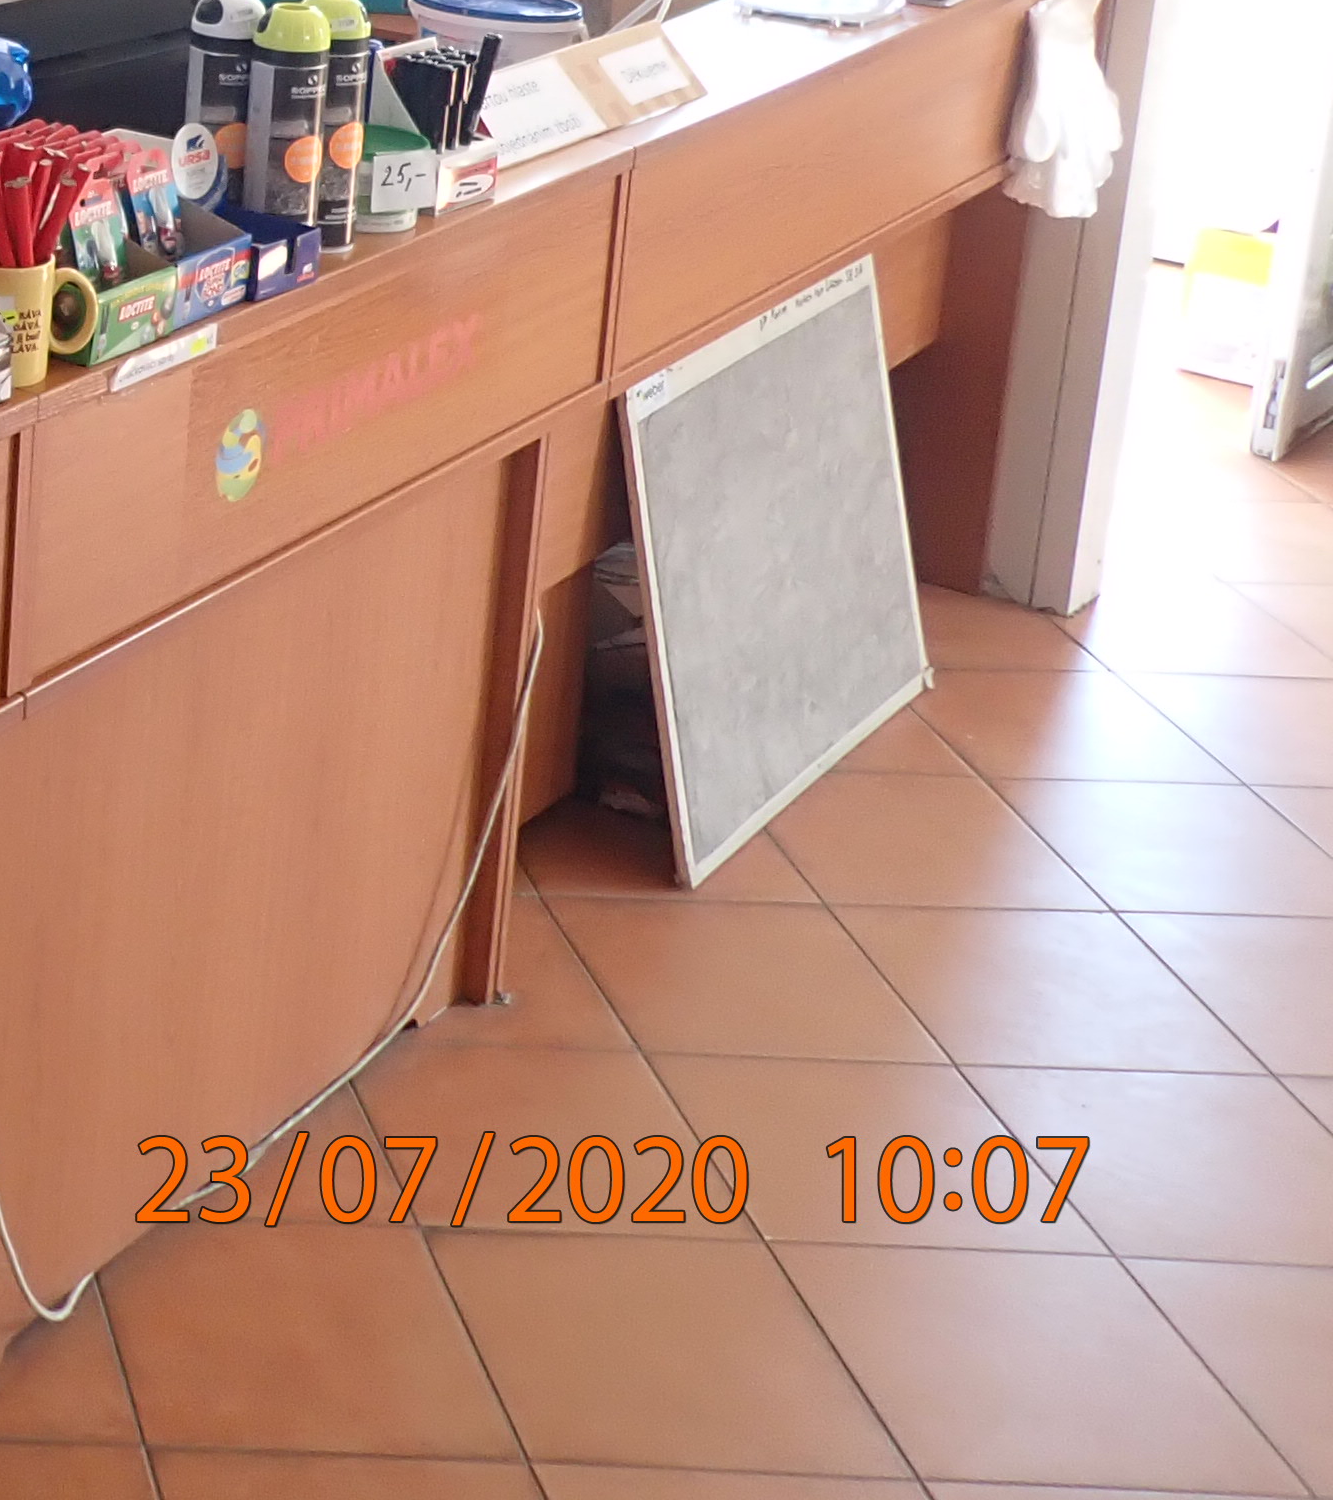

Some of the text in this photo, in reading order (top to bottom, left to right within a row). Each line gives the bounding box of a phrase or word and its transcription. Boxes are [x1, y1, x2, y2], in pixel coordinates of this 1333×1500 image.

[134, 169, 169, 195] LOCTITE
[381, 163, 427, 192] 25,-
[74, 201, 113, 227] LOCTITE
[198, 258, 233, 282] LOCTITE
[119, 296, 155, 321] LOCTITE
[273, 314, 483, 463] PRIMALEX
[642, 380, 665, 400] weber
